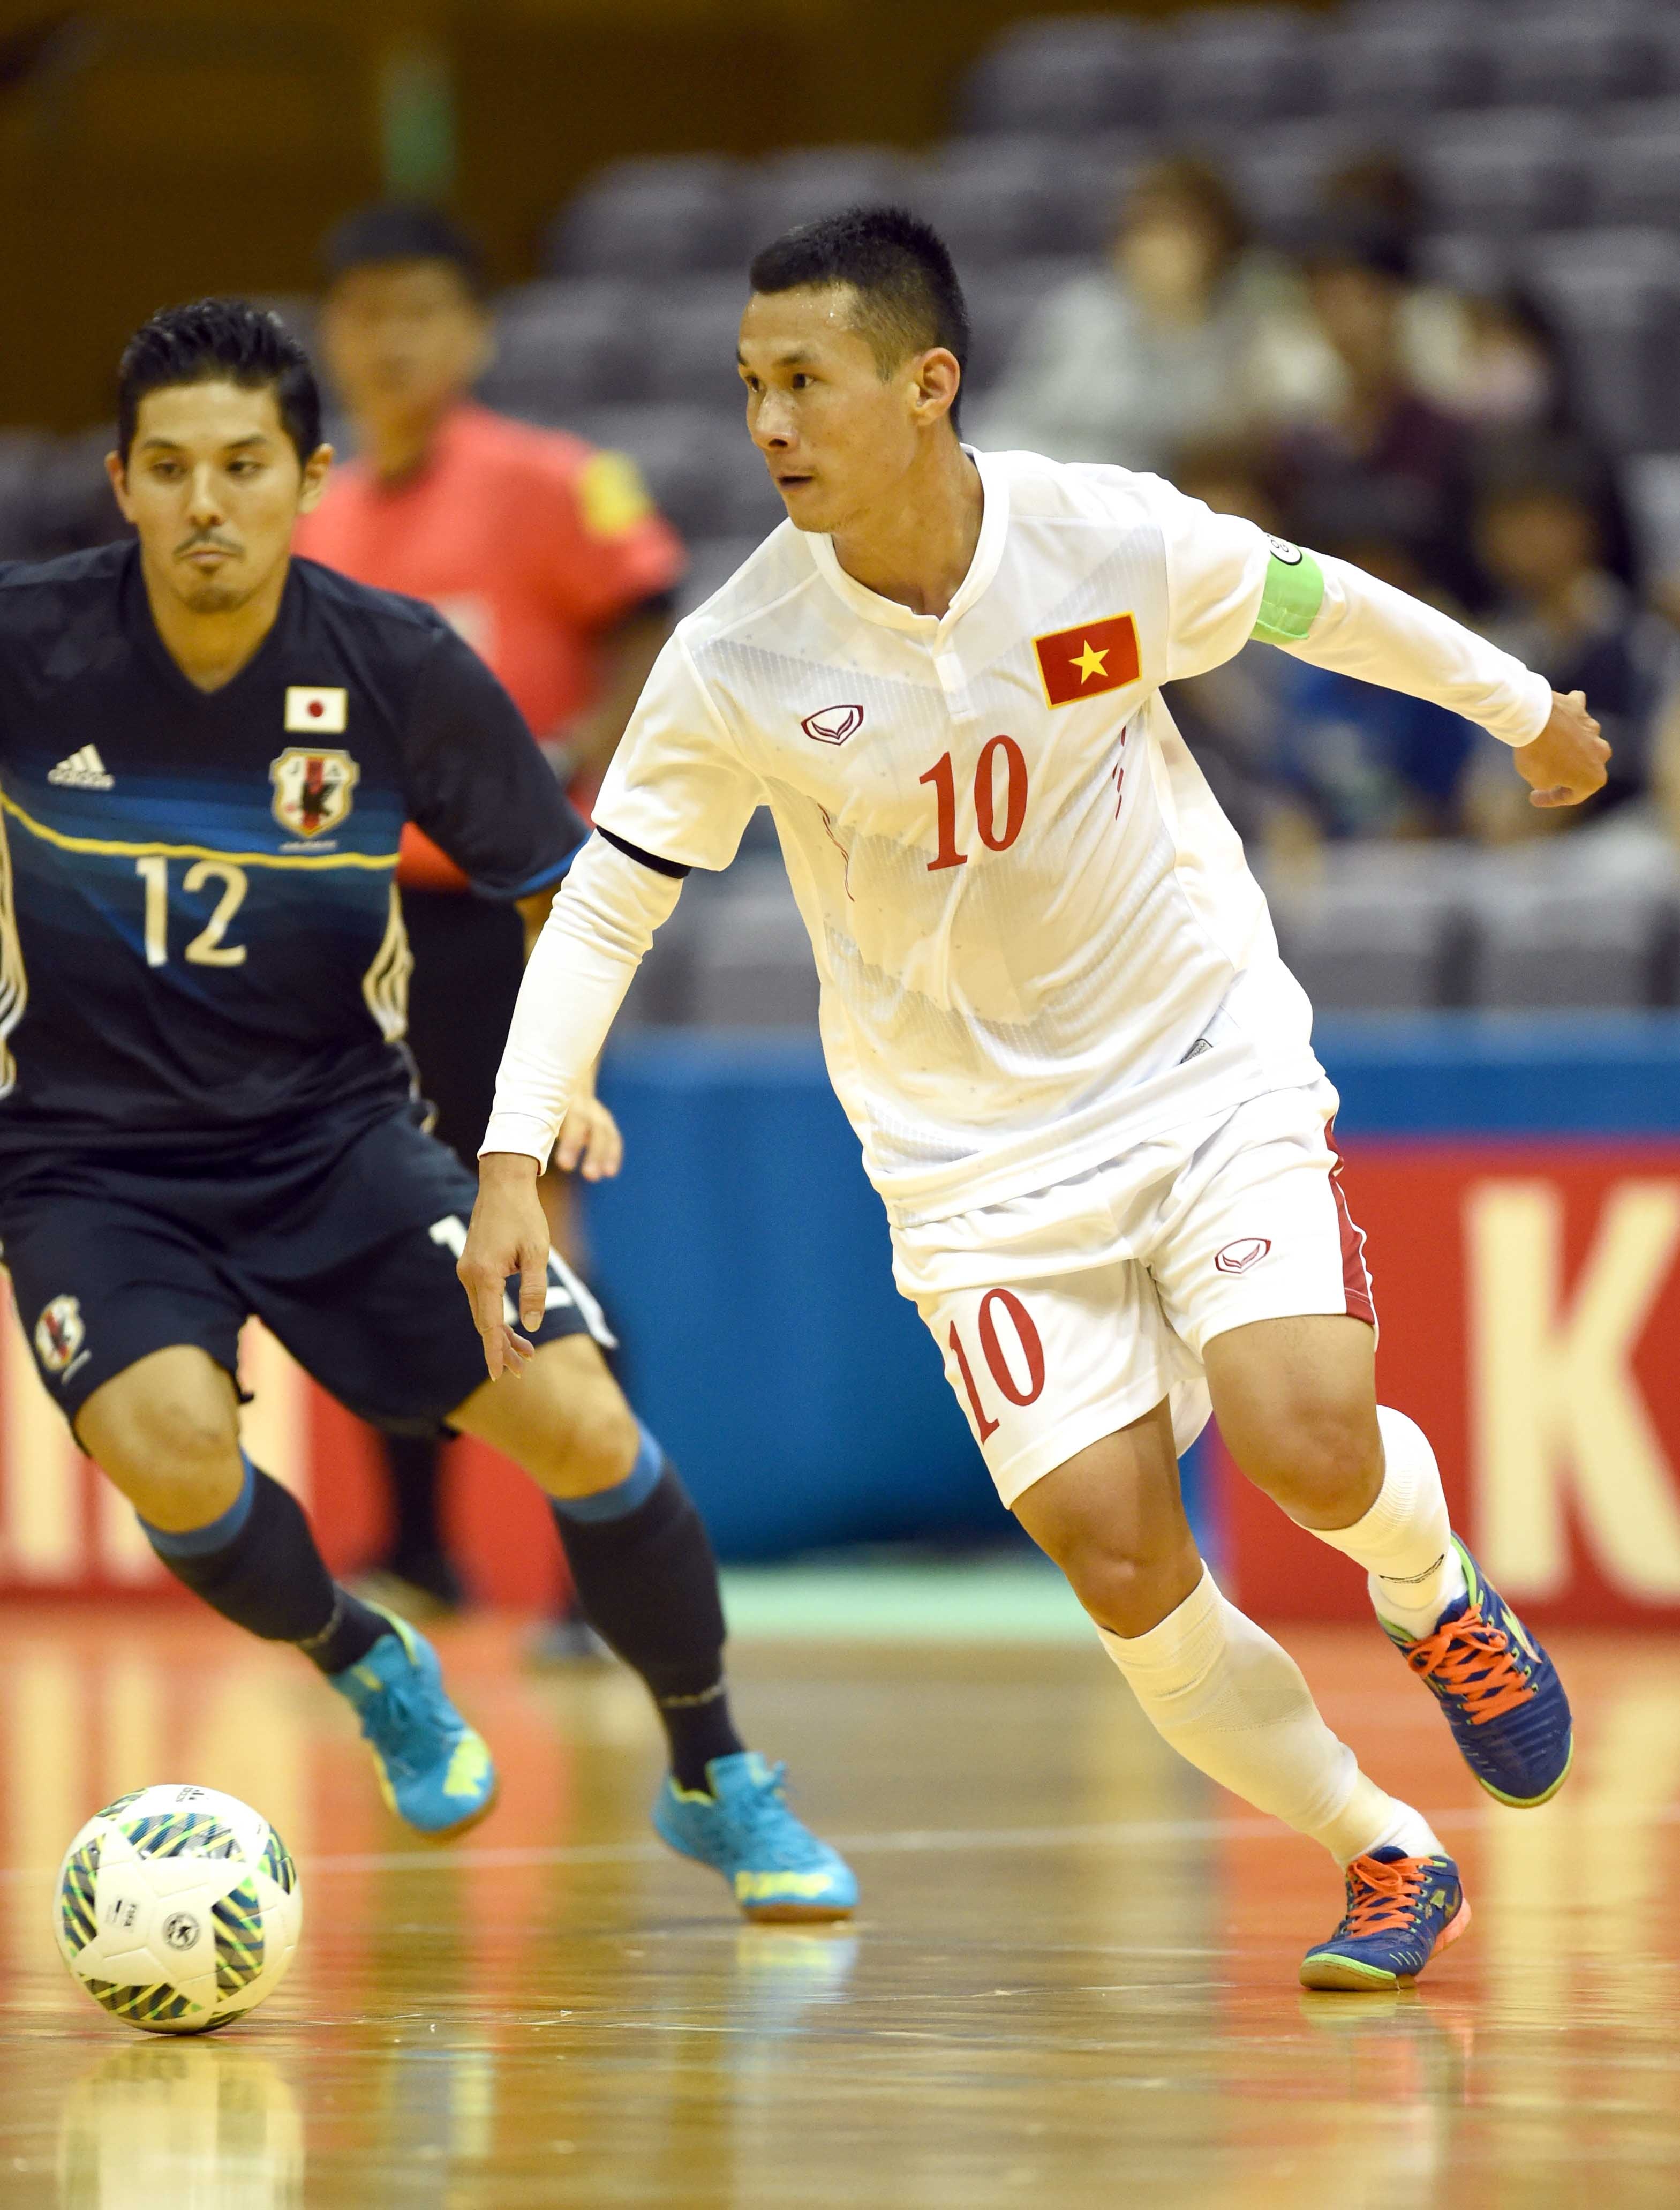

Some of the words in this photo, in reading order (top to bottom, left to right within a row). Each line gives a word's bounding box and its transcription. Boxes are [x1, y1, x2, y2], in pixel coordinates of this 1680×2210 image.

[919, 734, 1028, 871] 10
[136, 856, 249, 967] 12
[948, 1288, 1045, 1443] 10
[1470, 1178, 1680, 1602] K
